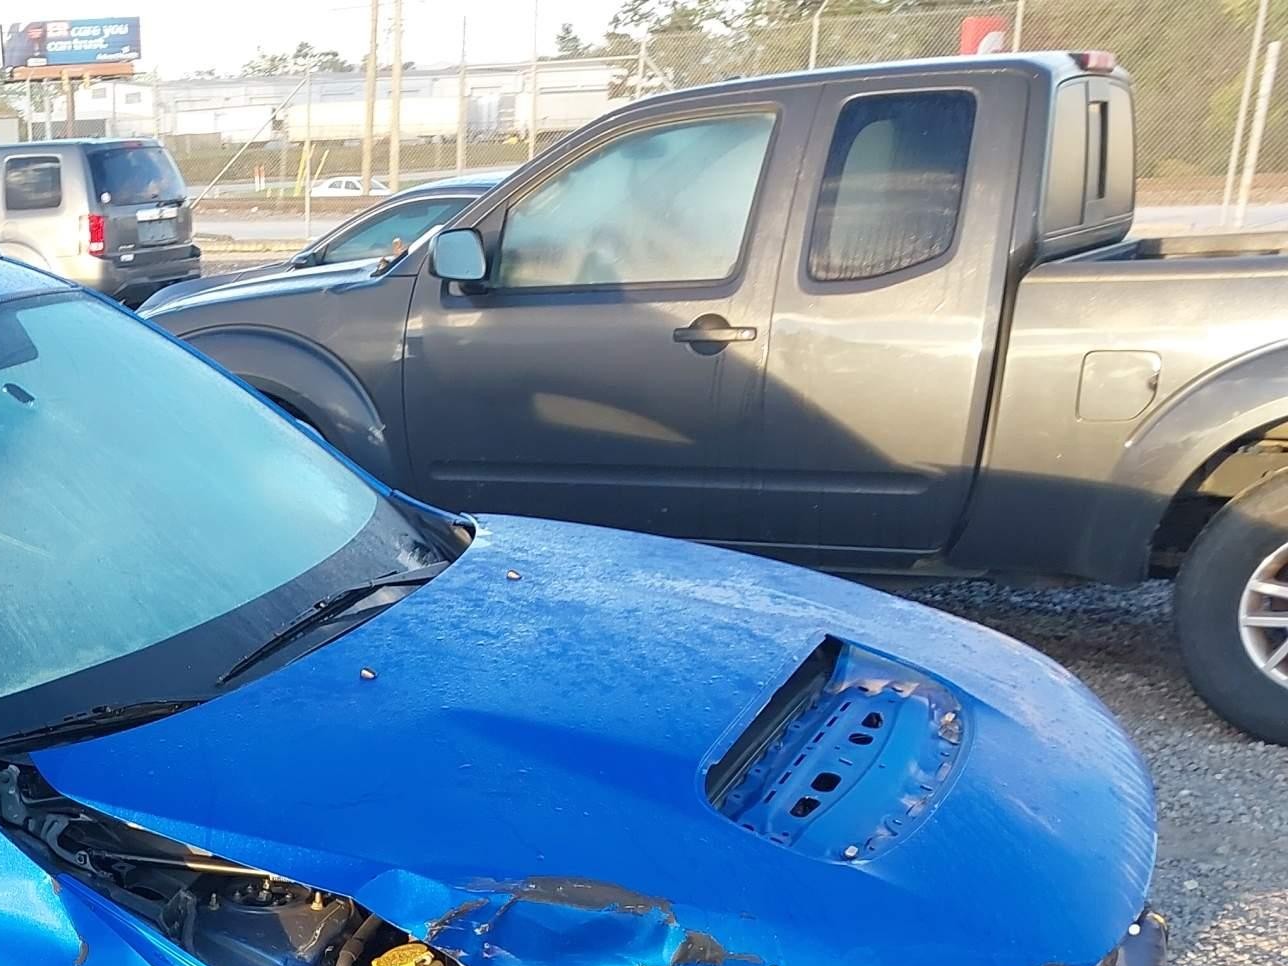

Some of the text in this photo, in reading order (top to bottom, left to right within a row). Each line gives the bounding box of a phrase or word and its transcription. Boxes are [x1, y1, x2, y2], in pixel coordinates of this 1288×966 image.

[47, 22, 128, 39] ER care you
[47, 40, 72, 51] can
